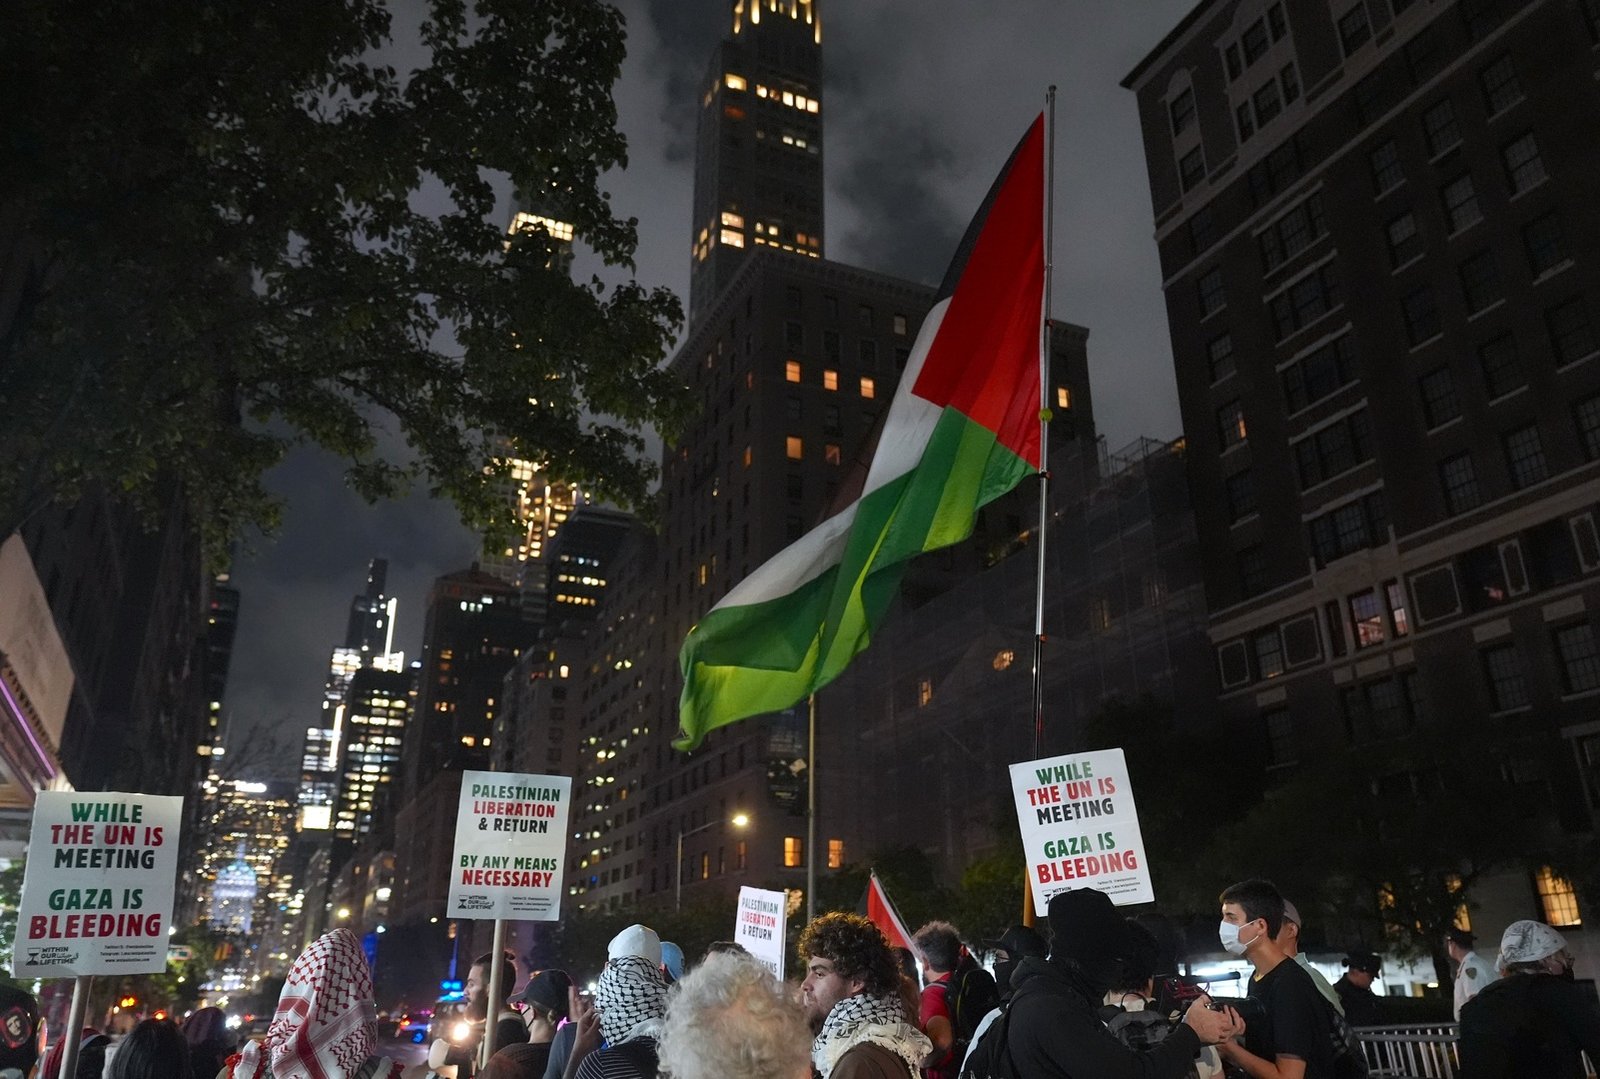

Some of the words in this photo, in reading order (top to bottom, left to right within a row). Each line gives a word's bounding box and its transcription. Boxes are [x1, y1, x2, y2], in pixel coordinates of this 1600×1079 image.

[1036, 761, 1093, 785] WHILE
[472, 784, 560, 801] PALESTINIAN
[1027, 785, 1061, 806] THE
[1066, 780, 1092, 800] UN
[1097, 777, 1116, 795] IS
[71, 803, 142, 823] WHILE
[473, 801, 555, 817] LIBERATION
[1037, 798, 1114, 825] MEETING
[478, 817, 488, 830] &
[493, 818, 548, 833] RETURN
[51, 825, 95, 845] THE
[104, 825, 136, 845] UN
[144, 827, 163, 846] IS
[1044, 835, 1092, 859] GAZA
[1097, 831, 1115, 851] IS
[54, 848, 155, 869] MEETING
[460, 855, 478, 868] BY
[482, 856, 509, 869] ANY
[514, 857, 557, 870] MEANS
[1036, 850, 1138, 884] BLEEDING
[462, 870, 553, 887] NECESSARY
[48, 888, 113, 911] GAZA
[122, 889, 143, 909] IS
[741, 897, 778, 914] PALESTINIAN
[29, 913, 161, 940] BLEEDING
[741, 911, 776, 928] LIBERATION
[748, 925, 772, 940] RETURN
